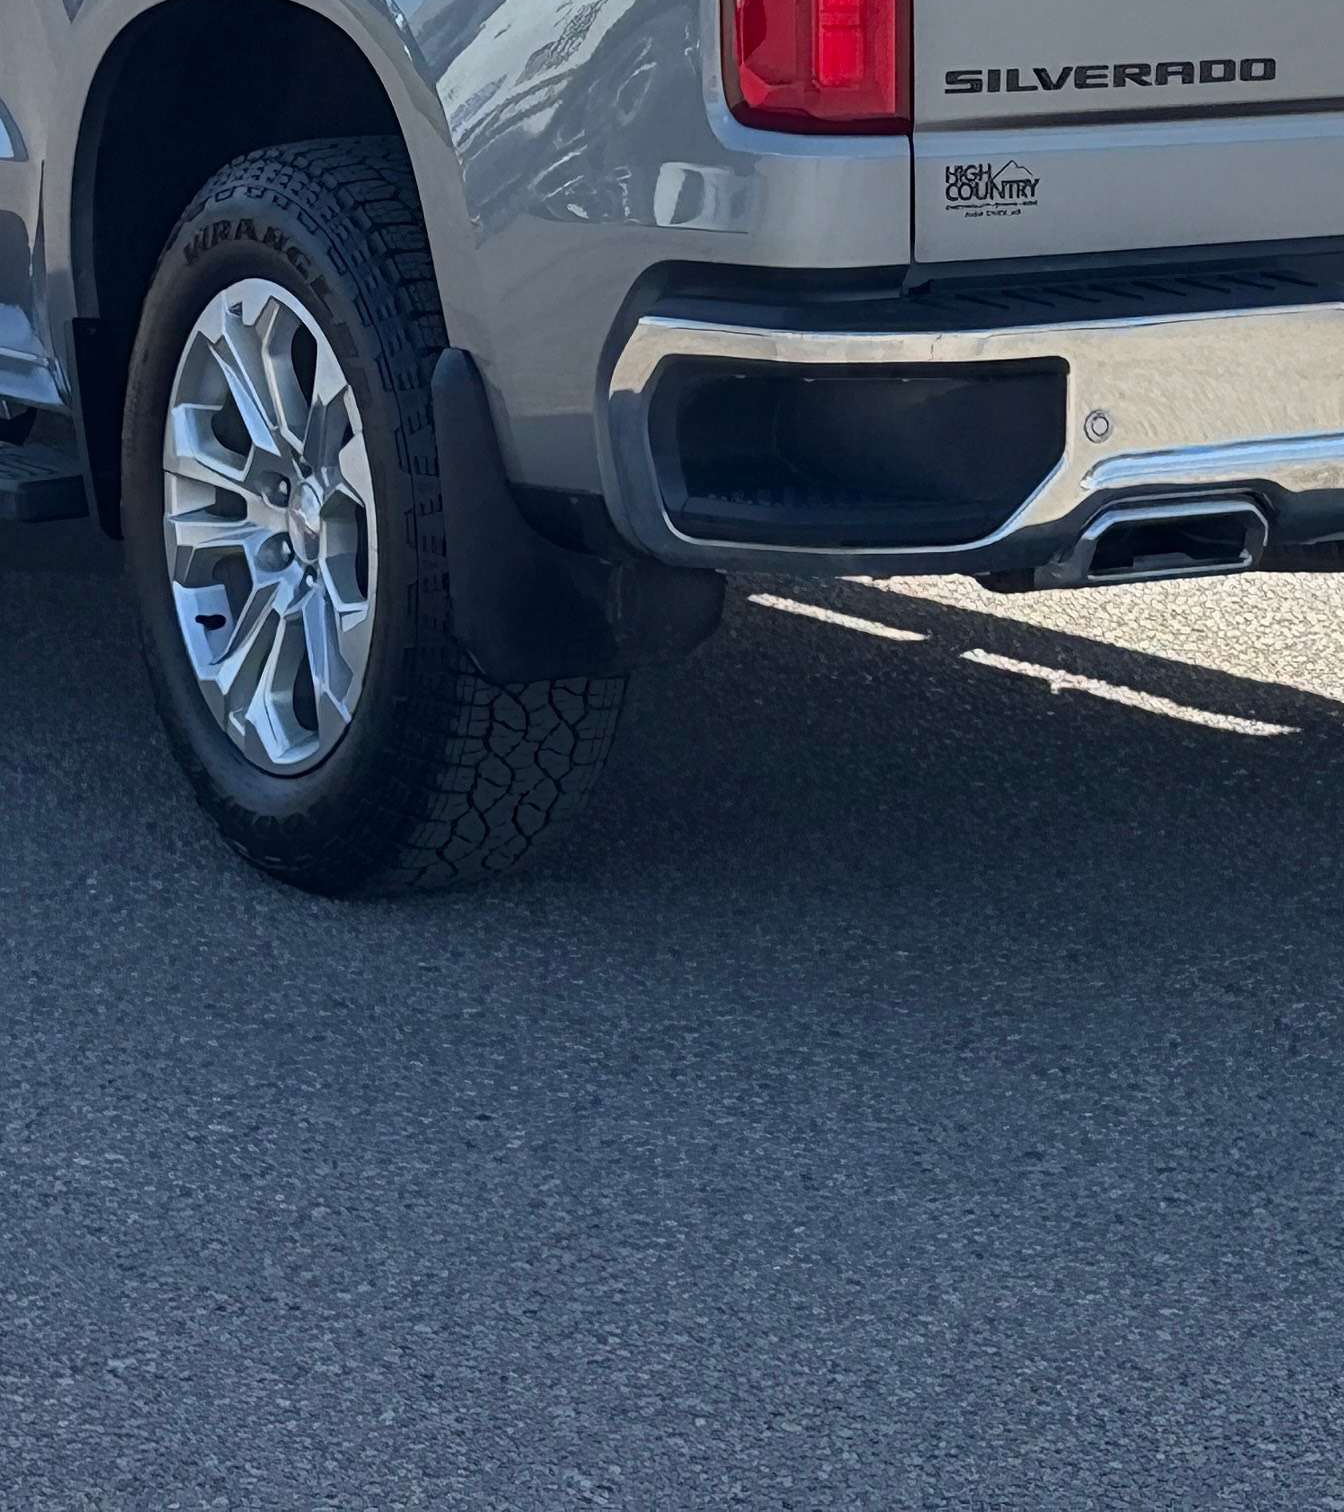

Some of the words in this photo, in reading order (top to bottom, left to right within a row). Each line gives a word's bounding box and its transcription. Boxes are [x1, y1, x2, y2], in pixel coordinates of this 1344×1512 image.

[944, 57, 1277, 94] SILVERADO
[945, 163, 992, 184] HIGH
[945, 178, 1040, 202] COUNTRY
